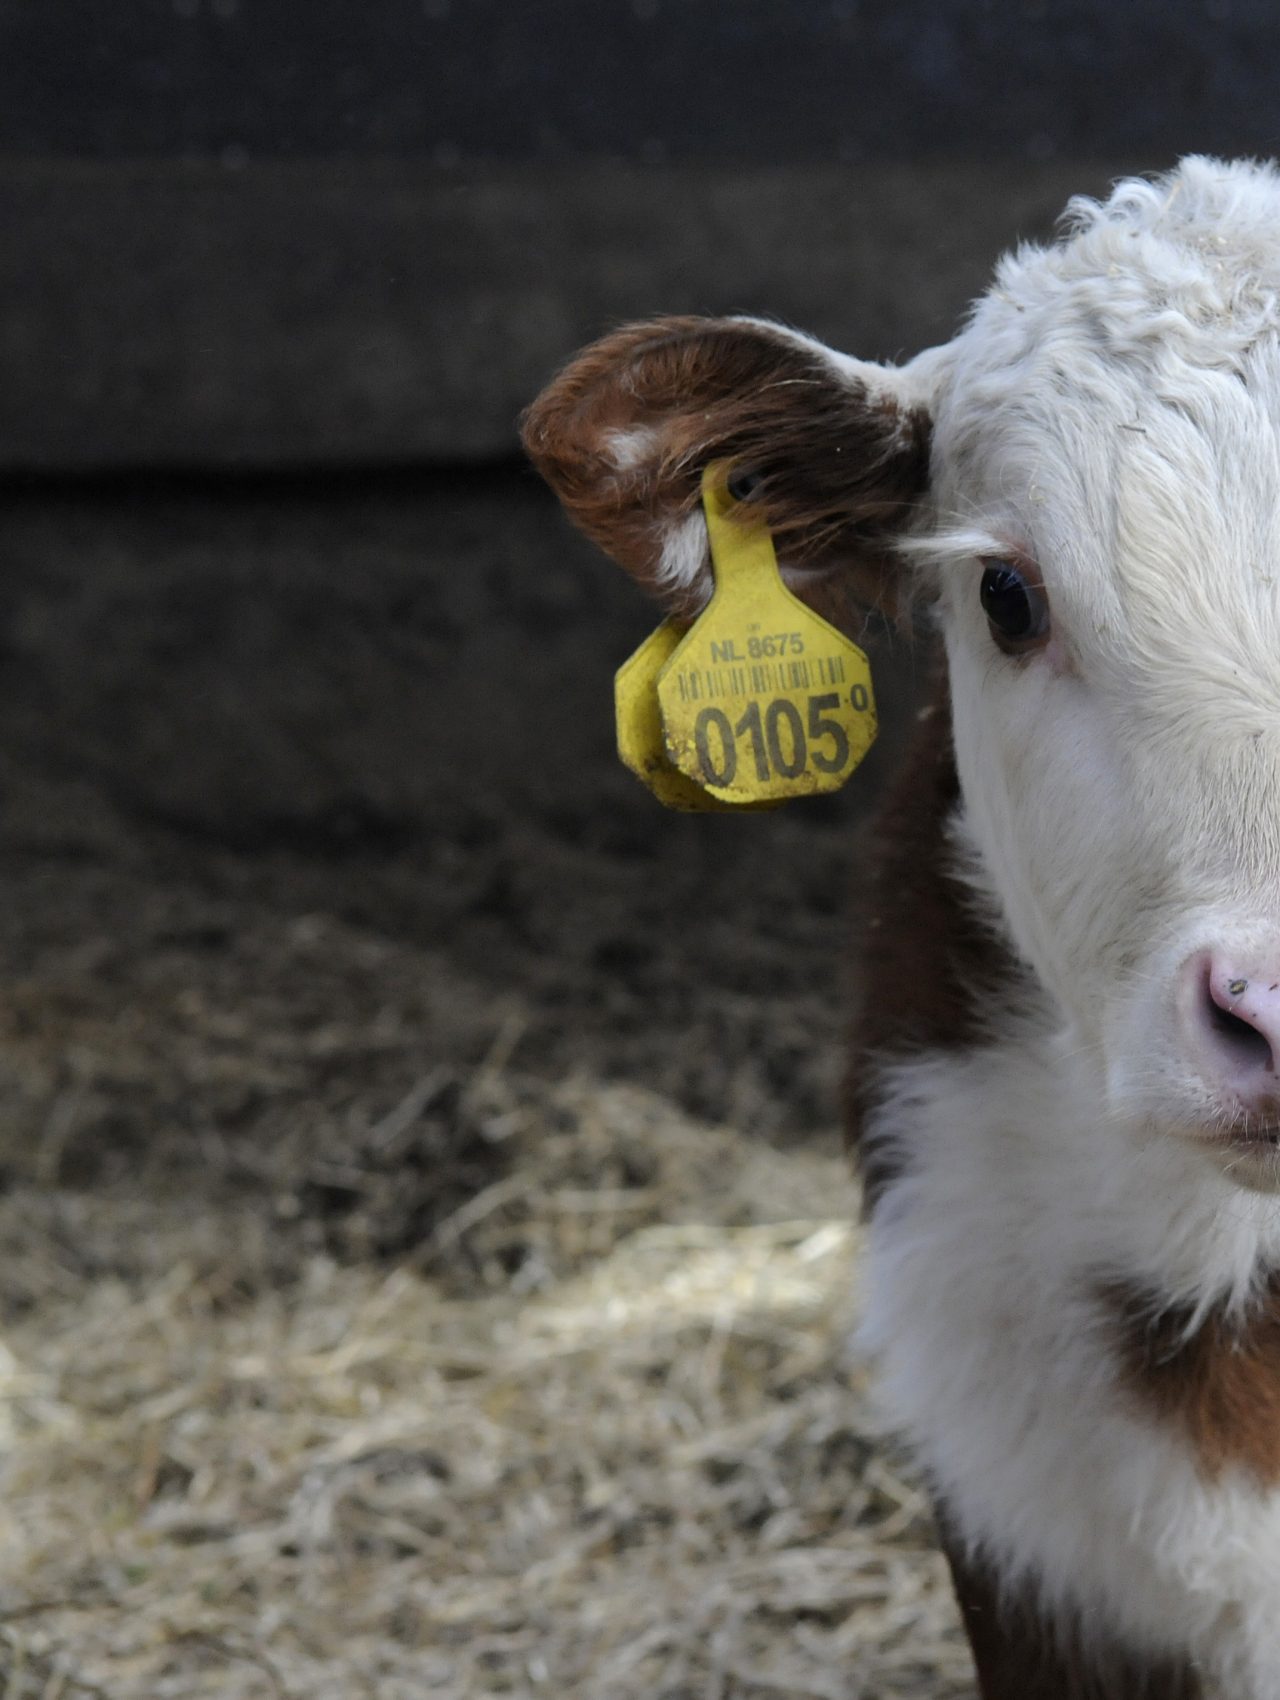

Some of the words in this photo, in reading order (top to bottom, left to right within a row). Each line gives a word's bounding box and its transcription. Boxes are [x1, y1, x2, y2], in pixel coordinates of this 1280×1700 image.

[710, 639, 745, 664] NL
[747, 632, 804, 659] 8675
[694, 692, 849, 788] 0105
